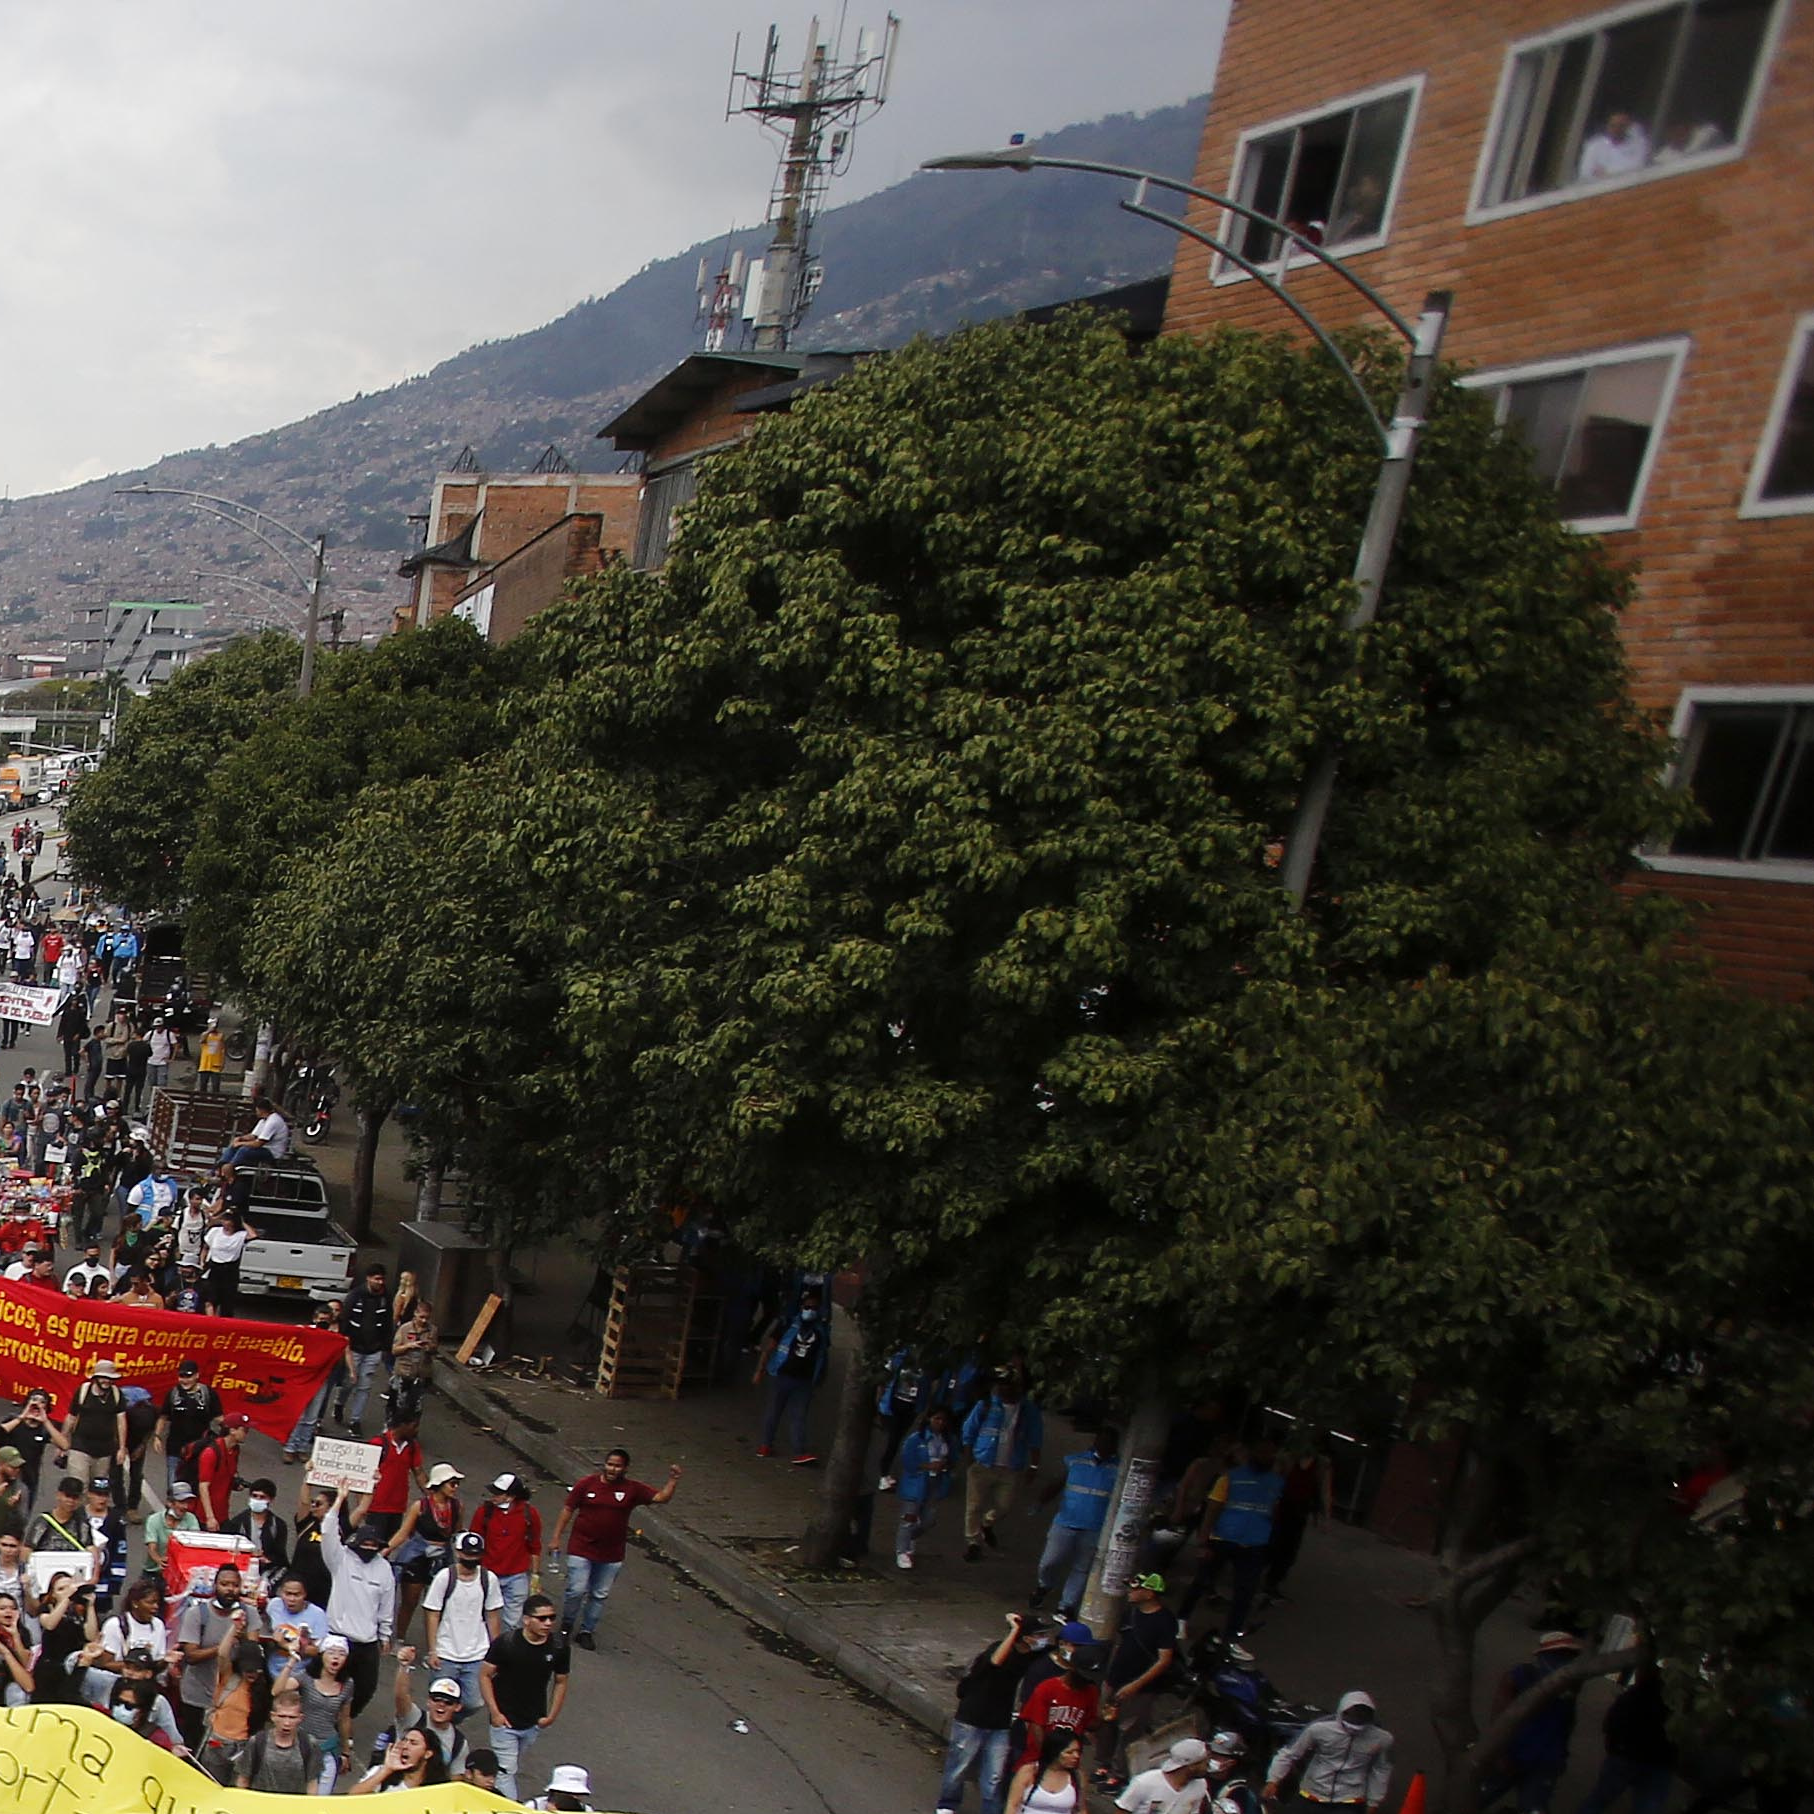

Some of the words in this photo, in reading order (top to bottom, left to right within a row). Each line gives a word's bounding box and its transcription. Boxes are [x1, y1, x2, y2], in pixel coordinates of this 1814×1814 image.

[46, 1314, 70, 1338] es
[73, 1316, 139, 1349] guerra
[143, 1327, 206, 1350] contra
[212, 1332, 231, 1350] el
[13, 1380, 58, 1406] lua
[210, 1375, 260, 1395] Faro
